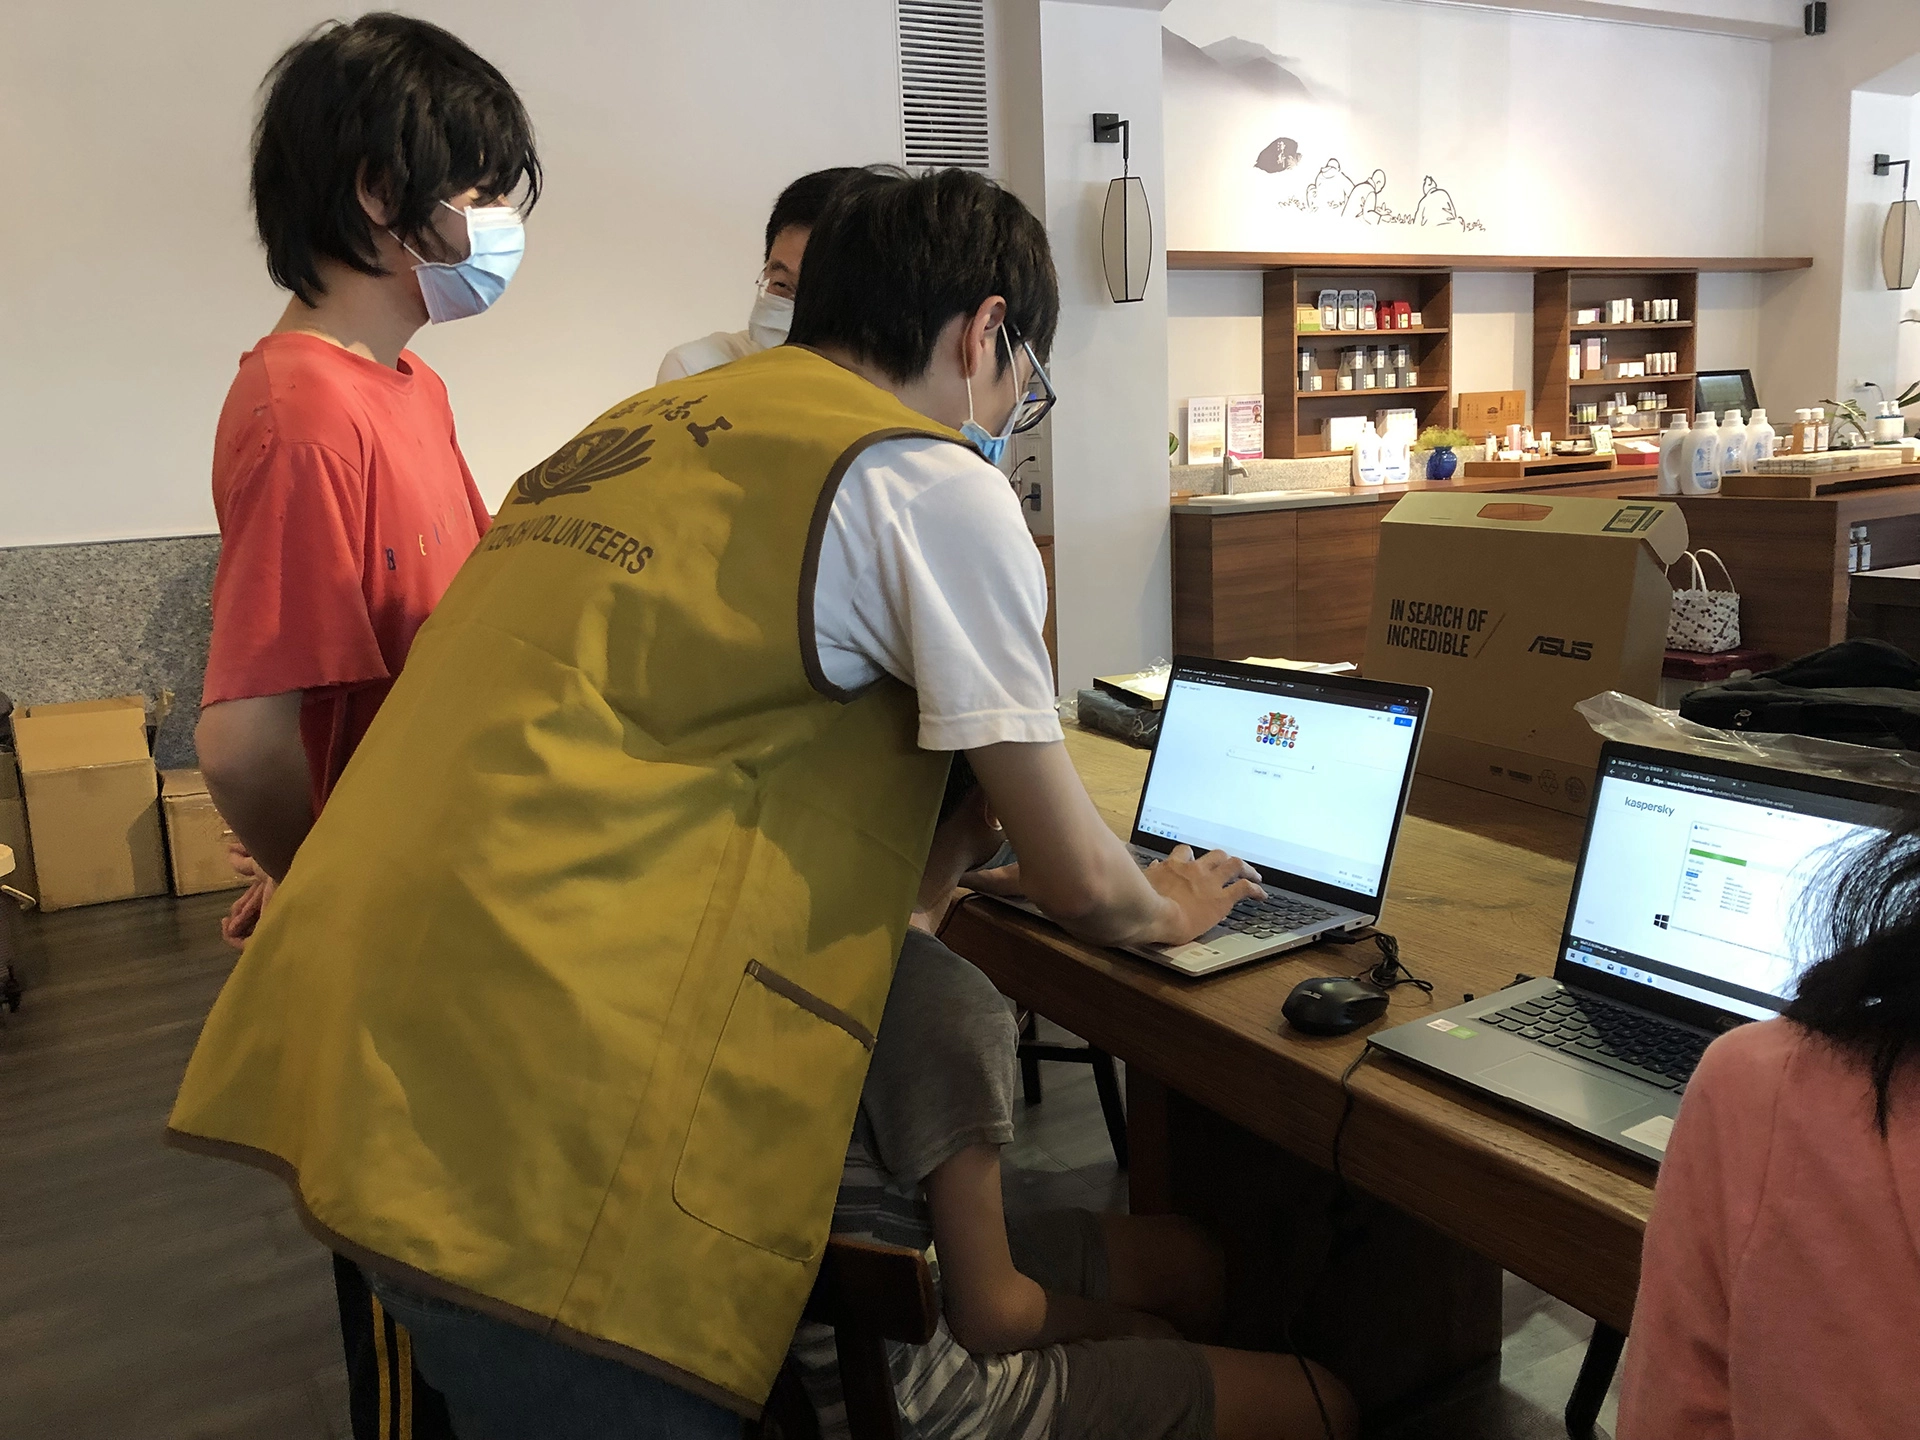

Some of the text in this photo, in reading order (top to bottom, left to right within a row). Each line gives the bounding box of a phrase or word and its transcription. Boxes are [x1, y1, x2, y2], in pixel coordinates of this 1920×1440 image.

[525, 514, 654, 575] VOLUNTEERS
[1390, 598, 1489, 632] IN SEARCH OF
[1387, 623, 1472, 658] INCREDIBLE
[1527, 635, 1594, 662] ASUS
[1624, 796, 1675, 818] kaspersky
